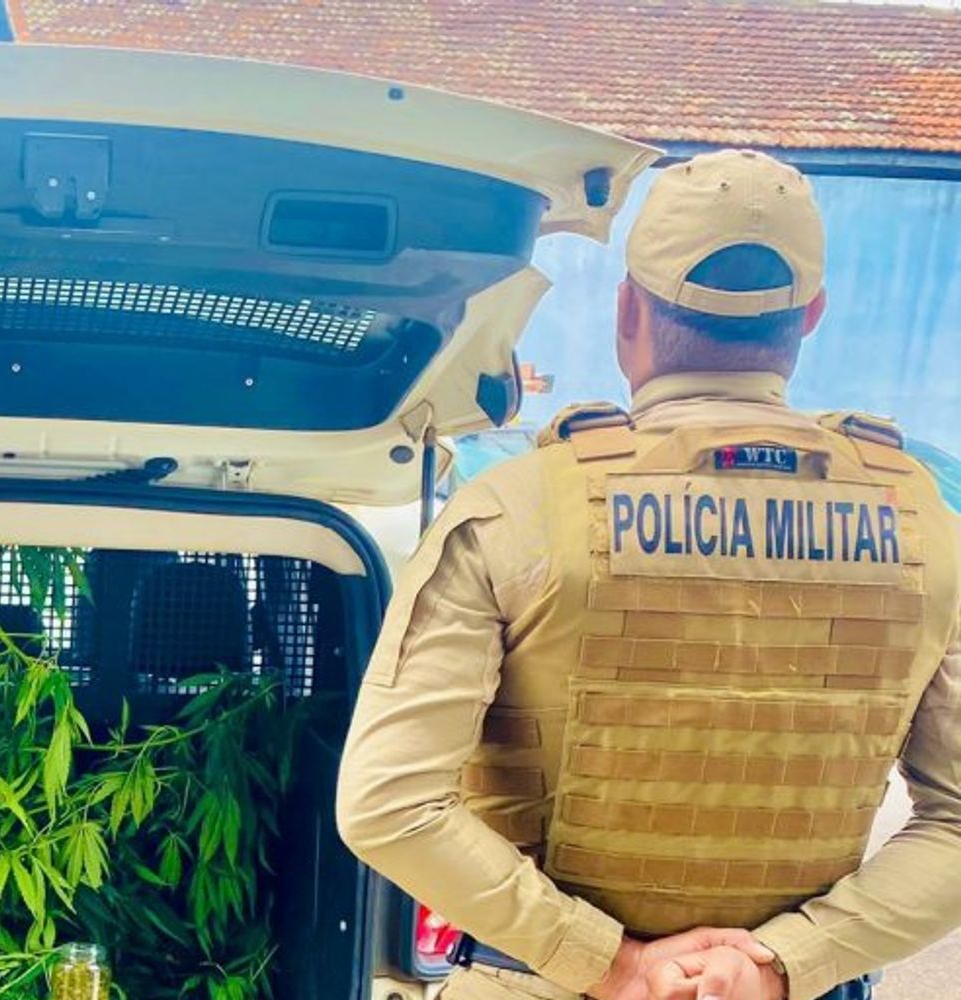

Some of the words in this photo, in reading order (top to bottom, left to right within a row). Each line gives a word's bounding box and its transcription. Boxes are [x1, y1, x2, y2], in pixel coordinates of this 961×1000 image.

[743, 447, 787, 464] WTC
[613, 482, 755, 558] POLÍCIA
[765, 498, 899, 563] MILITAR
